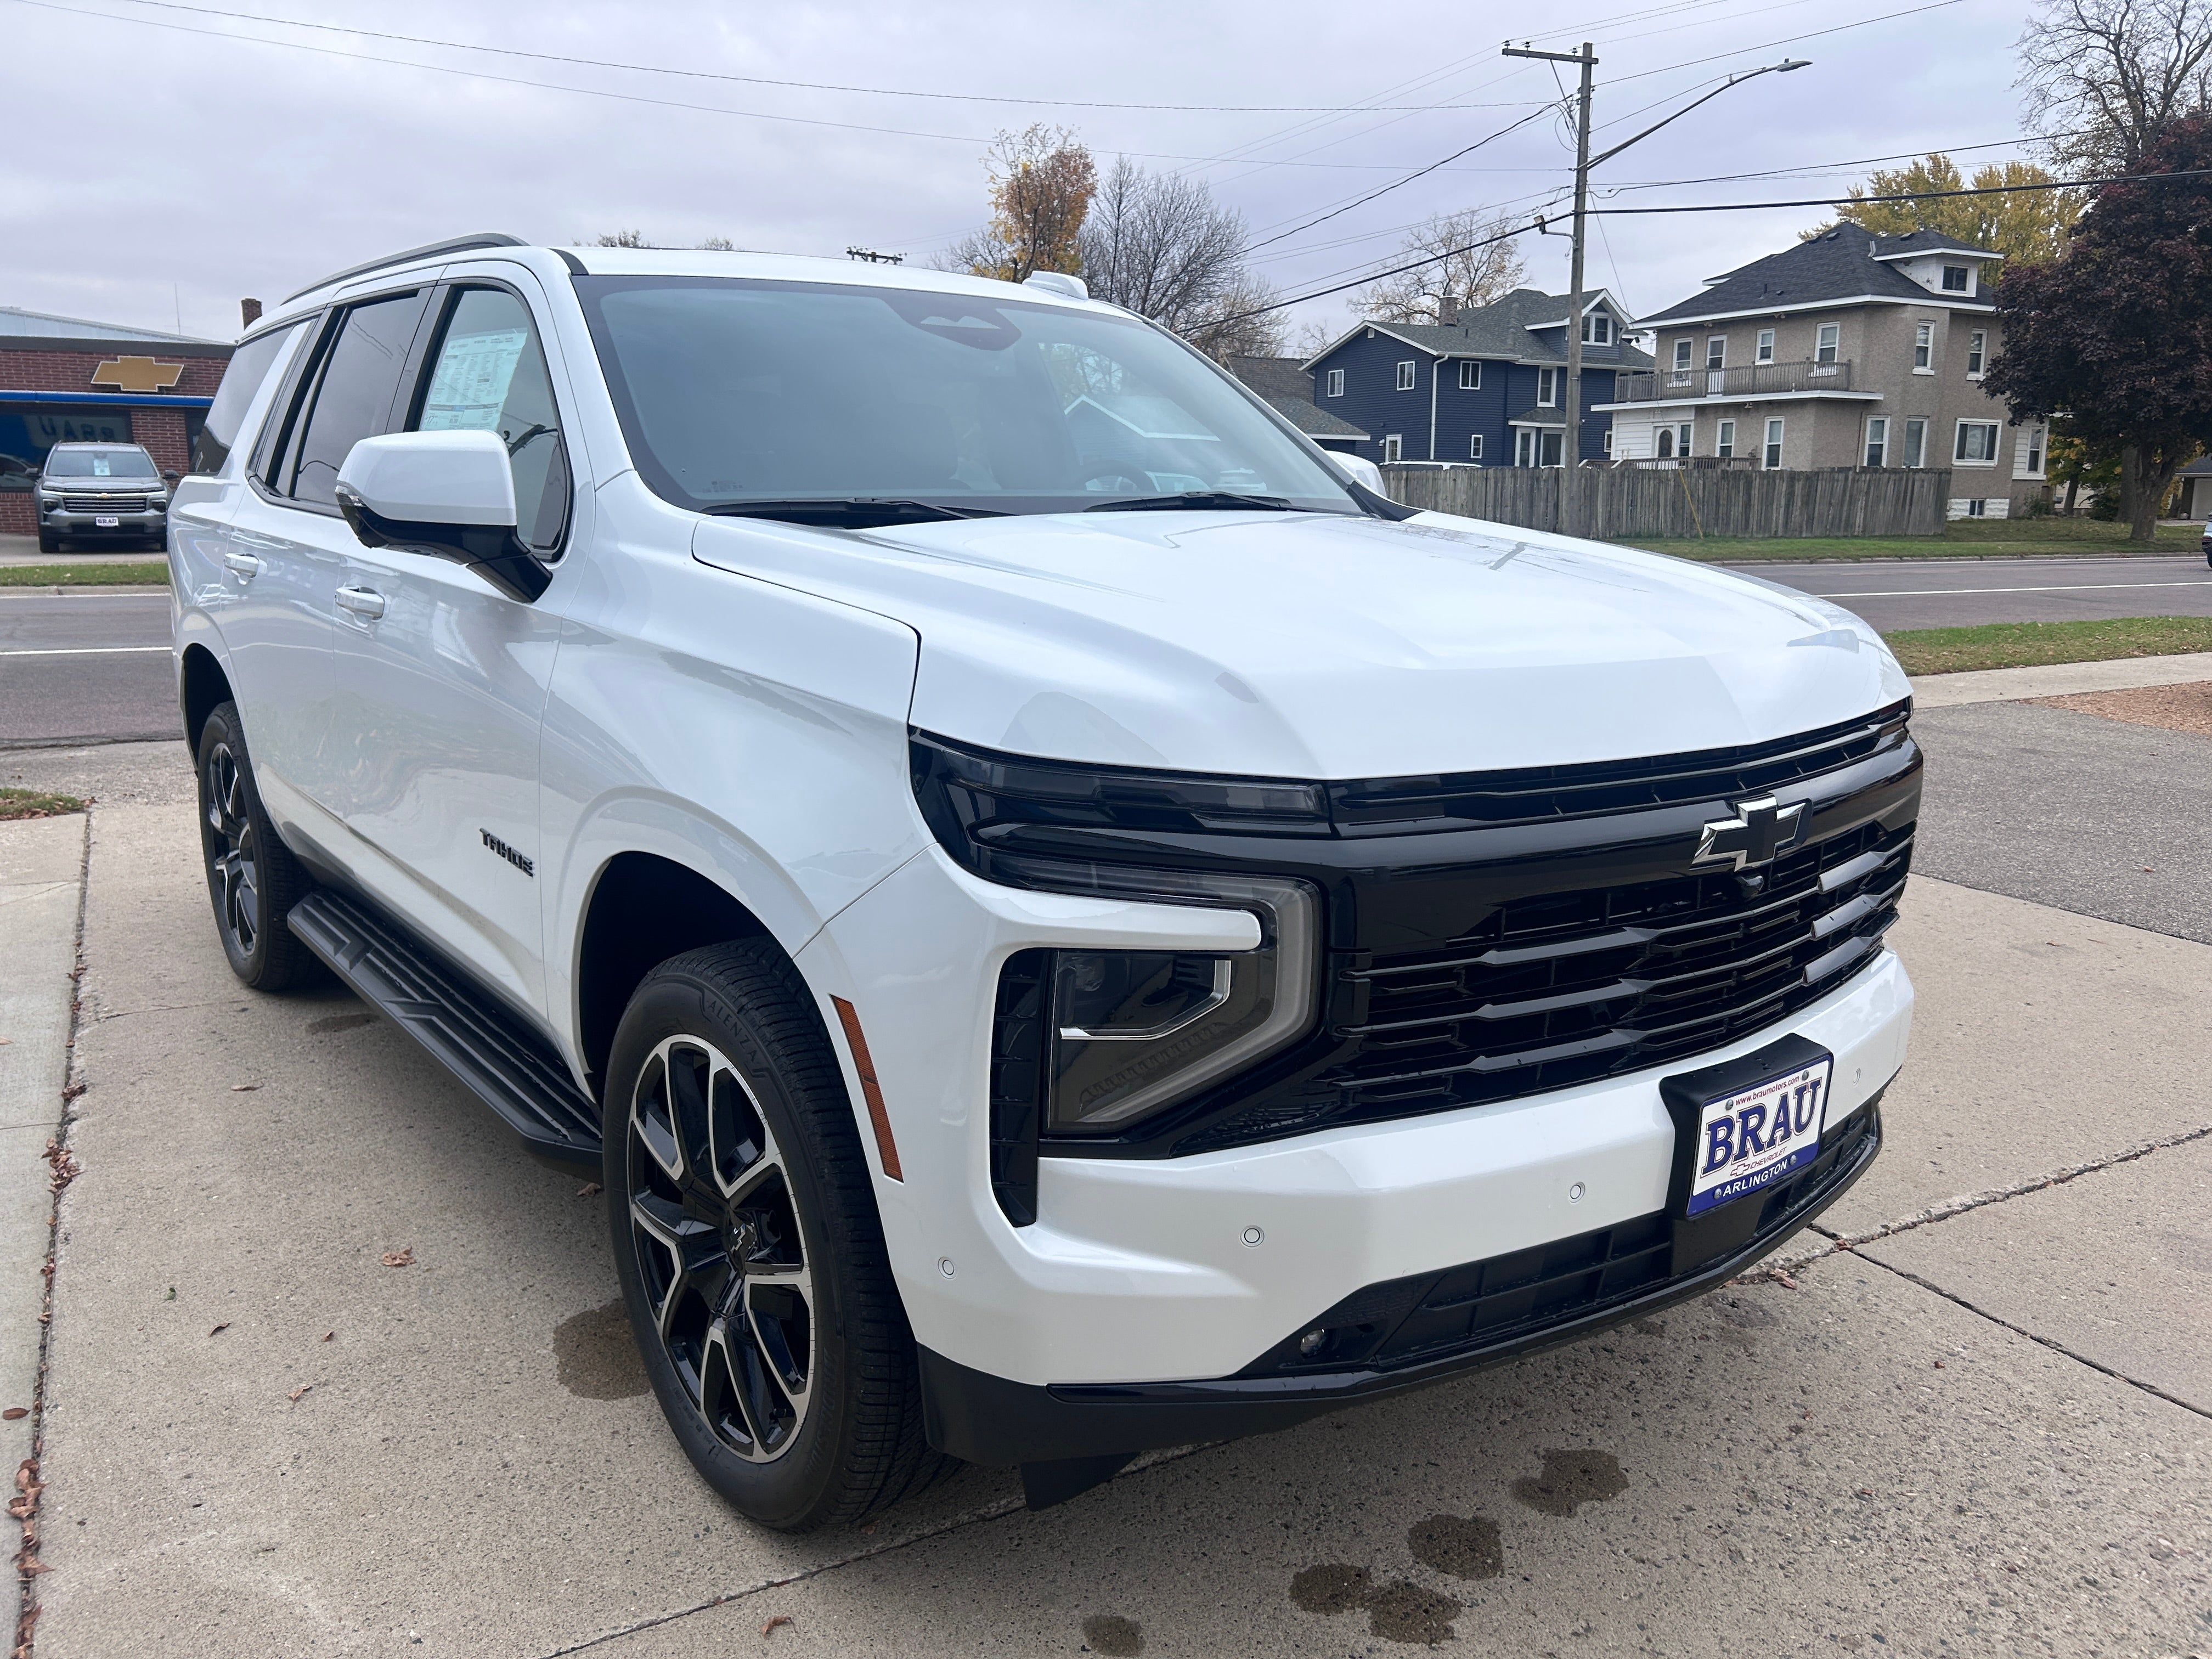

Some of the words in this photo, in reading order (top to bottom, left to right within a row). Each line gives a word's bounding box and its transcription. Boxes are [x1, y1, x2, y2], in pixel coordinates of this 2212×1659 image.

[479, 827, 534, 877] TAHOE
[708, 1000, 757, 1062] ALENZA
[1735, 1076, 1799, 1105] www.braumotors.com
[1700, 1077, 1822, 1179] BRAU
[1723, 1159, 1787, 1197] ARLINGTON
[1750, 1147, 1787, 1169] CHEVROLET
